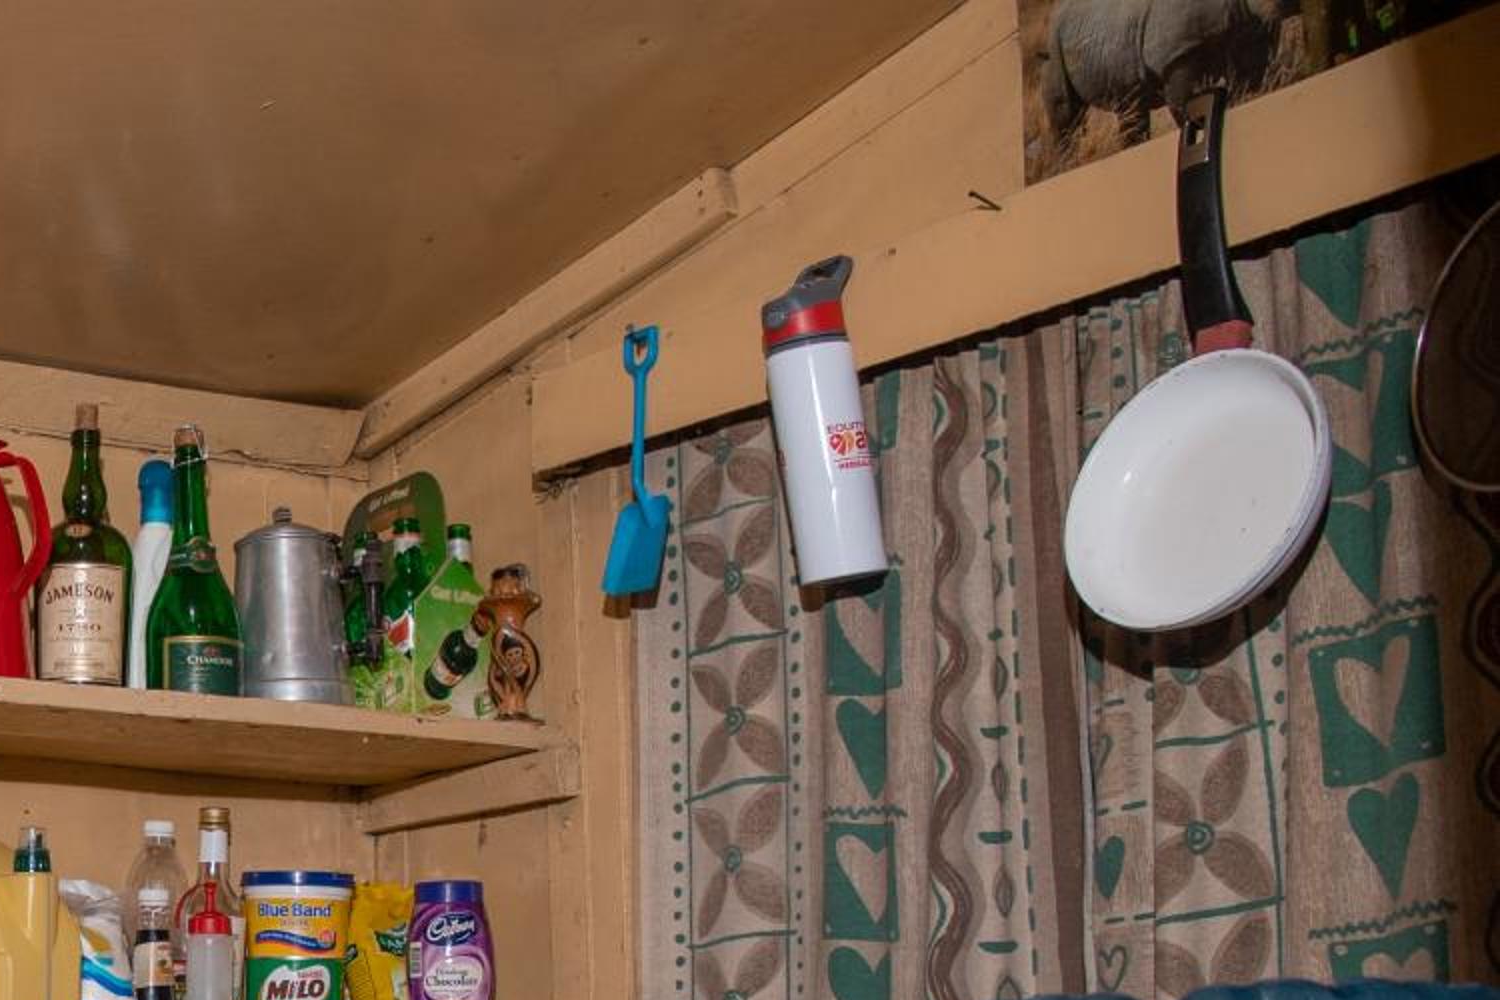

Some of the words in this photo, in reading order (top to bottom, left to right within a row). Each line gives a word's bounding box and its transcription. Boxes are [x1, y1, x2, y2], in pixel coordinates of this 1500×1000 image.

[45, 583, 115, 605] JAMESON
[259, 903, 288, 917] Blue
[292, 903, 331, 917] Band
[426, 974, 478, 988] Chocolate
